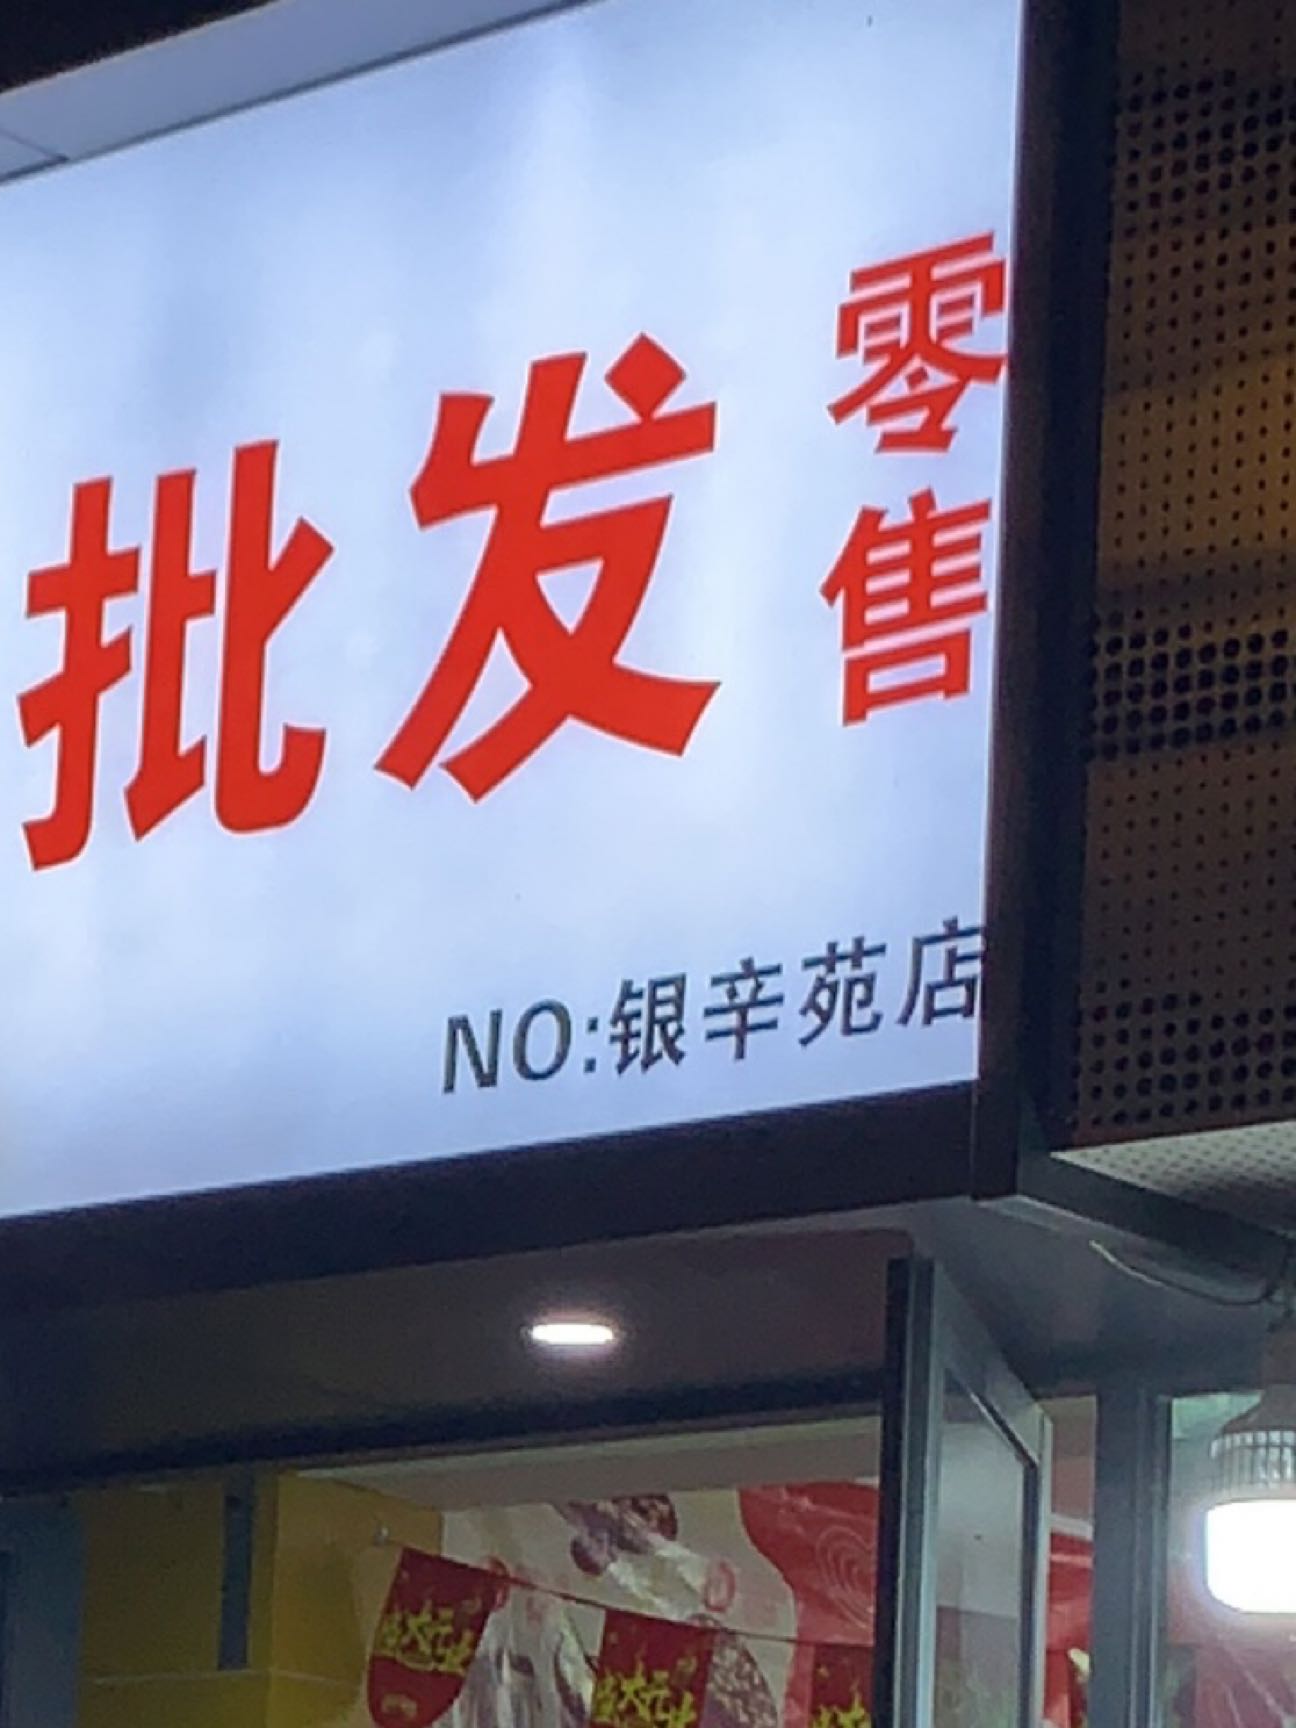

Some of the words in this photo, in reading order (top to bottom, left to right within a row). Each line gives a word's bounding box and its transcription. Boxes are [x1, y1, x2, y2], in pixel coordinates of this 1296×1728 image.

[823, 234, 1012, 724] 零售
[442, 916, 982, 1093] NO:银辛苑店
